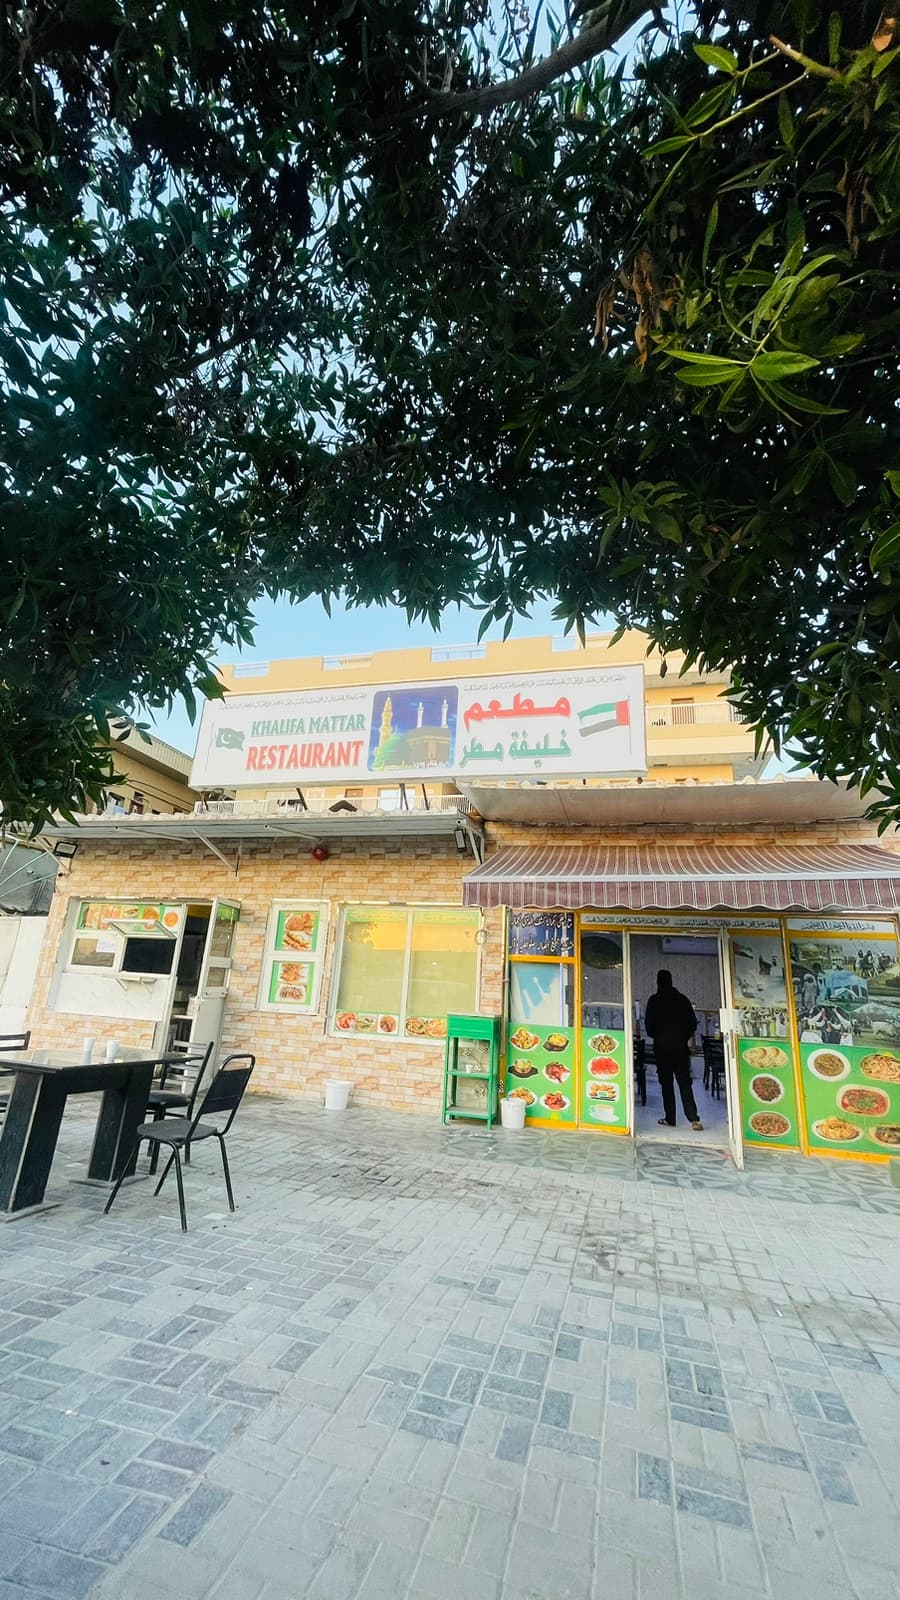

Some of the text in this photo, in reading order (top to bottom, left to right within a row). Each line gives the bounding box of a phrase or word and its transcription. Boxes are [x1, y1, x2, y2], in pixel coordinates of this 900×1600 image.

[250, 713, 366, 737] KHALIFA MATTAR
[463, 692, 571, 733] مطعم
[245, 740, 365, 771] RESTAURANT
[459, 729, 572, 768] خليفة مطر
